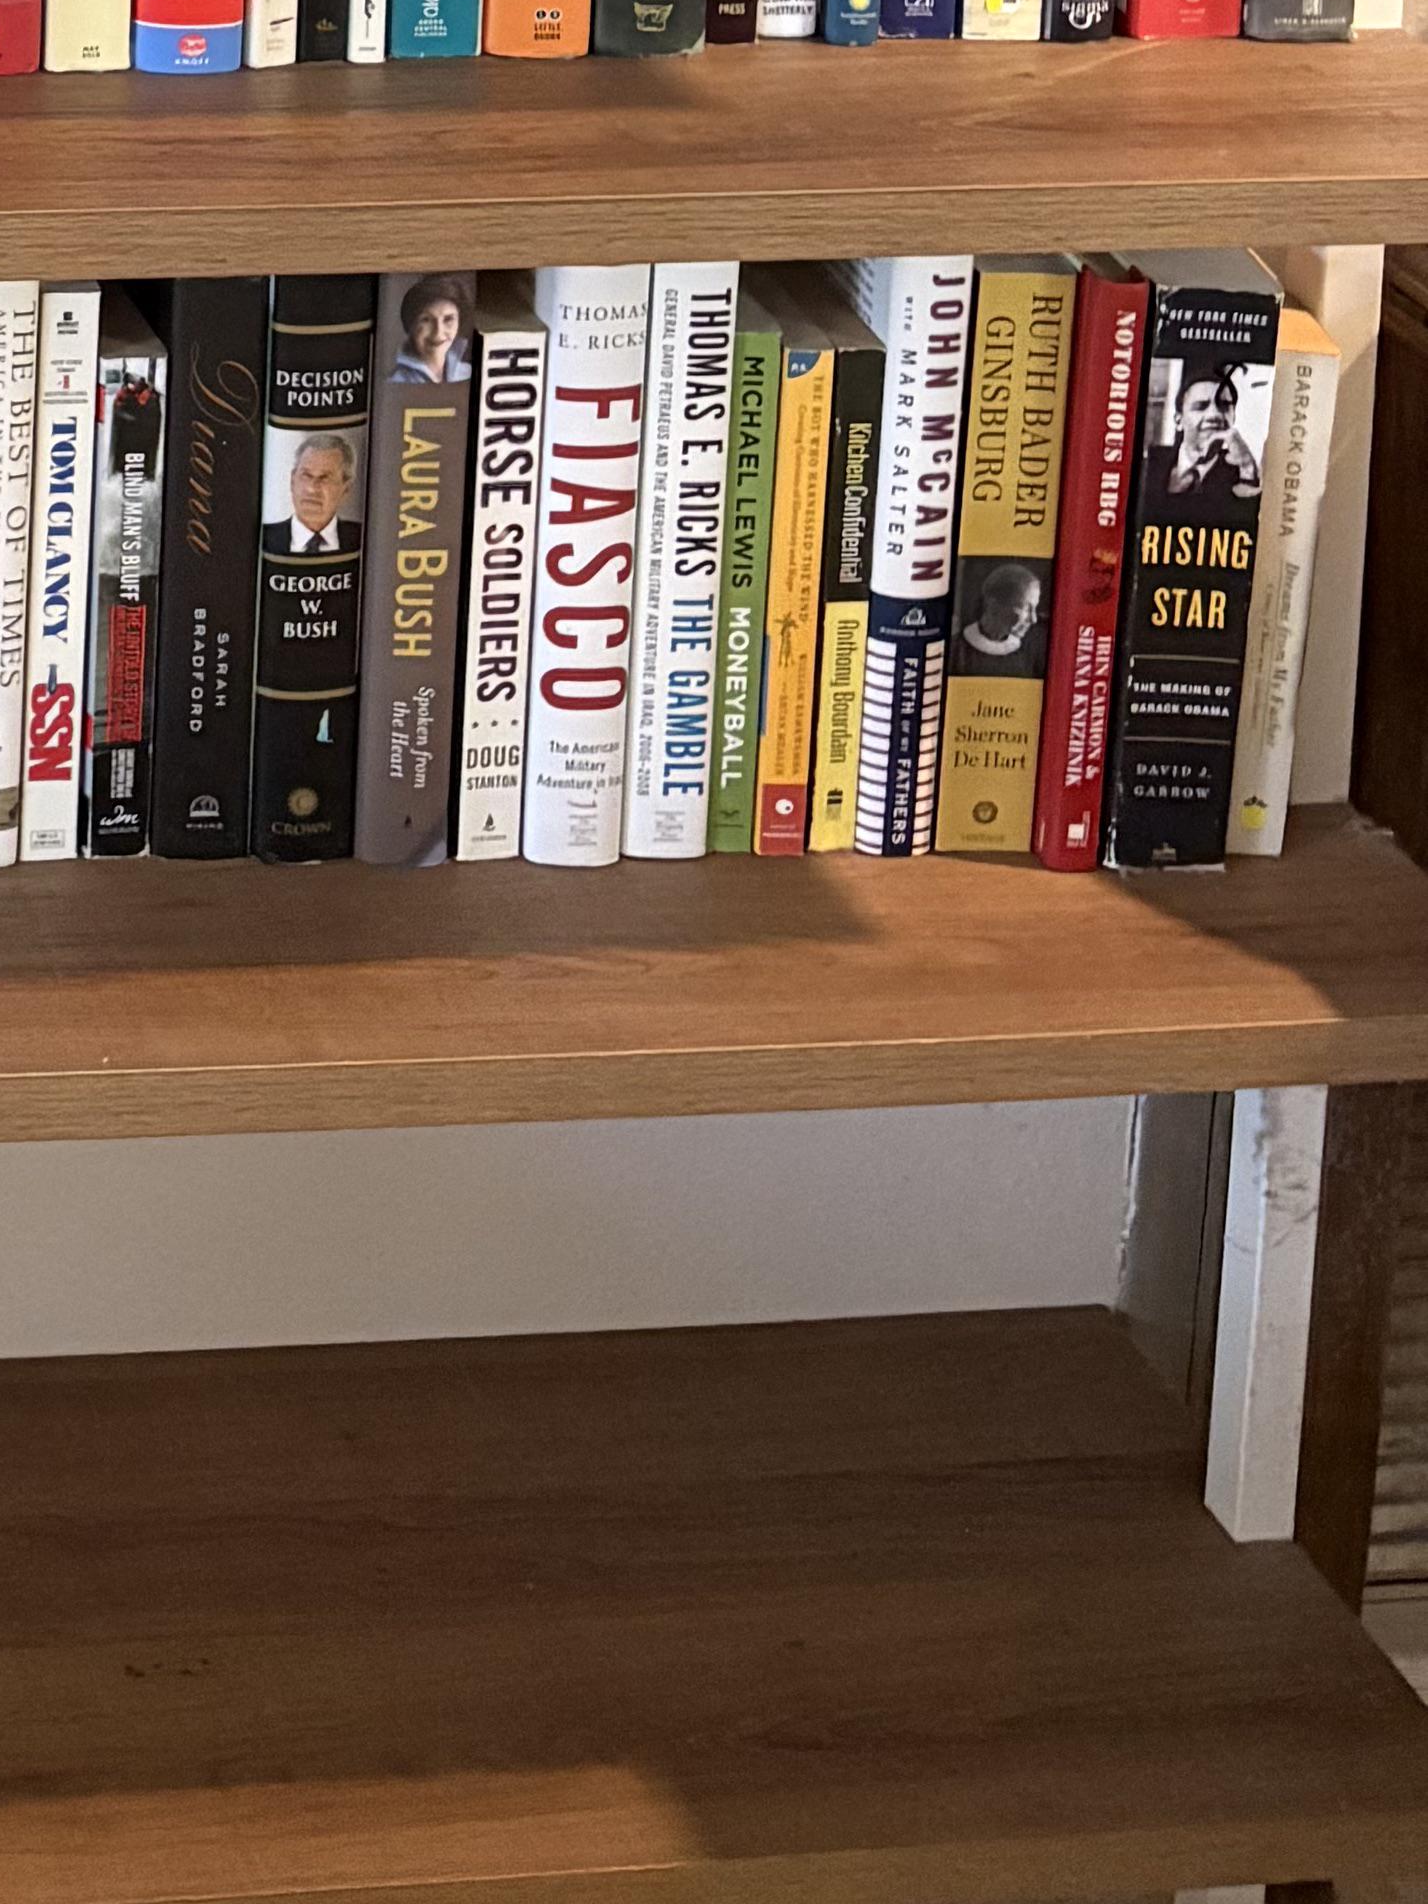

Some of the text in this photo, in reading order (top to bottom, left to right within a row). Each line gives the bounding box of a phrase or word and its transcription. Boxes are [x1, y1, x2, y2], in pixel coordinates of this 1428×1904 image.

[276, 368, 364, 389] DECISION
[286, 390, 353, 406] POINTS
[972, 314, 1017, 503] GINSBURG
[1097, 471, 1125, 528] RBG
[393, 408, 456, 660] LAURA BUSH
[540, 384, 642, 712] FIASCO
[1141, 526, 1253, 570] RISING
[1152, 590, 1226, 630] STAR
[28, 683, 75, 783] SSN
[466, 746, 520, 768] DOUG
[466, 774, 518, 790] STANTON
